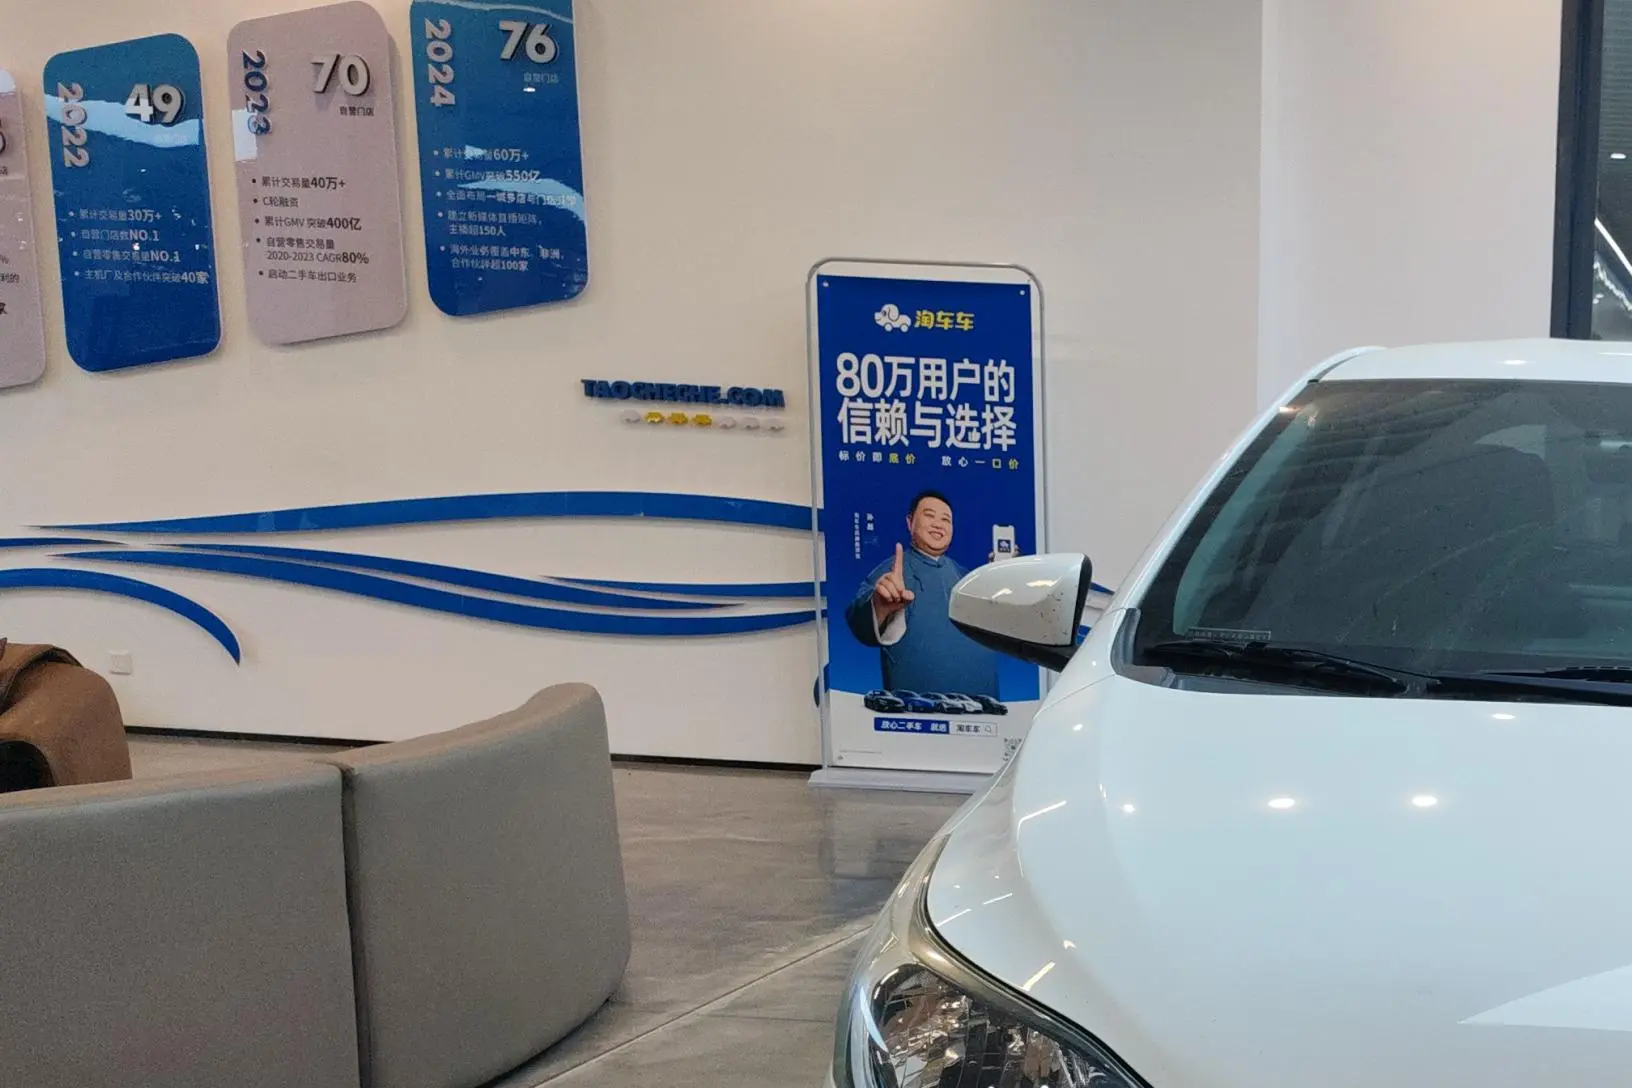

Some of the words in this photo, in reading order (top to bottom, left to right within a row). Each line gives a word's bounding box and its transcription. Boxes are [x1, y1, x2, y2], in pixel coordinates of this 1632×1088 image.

[499, 20, 559, 64] 76
[310, 53, 371, 97] 70
[424, 18, 456, 107] 2024
[125, 83, 185, 126] 49
[242, 49, 272, 136] 2023
[57, 82, 90, 168] 2022
[262, 176, 346, 190] 累计交易量40万+
[262, 196, 299, 208] C轮融资
[266, 236, 335, 250] 自营零售交易量
[267, 251, 315, 261] 2020-2023
[268, 269, 357, 283] 启动二手车出口业务
[914, 310, 975, 331] 淘车车
[581, 379, 786, 407] TAOCHECHE.COM
[836, 352, 1016, 403] 80万用户的
[837, 397, 1017, 451] 信赖与选择
[941, 455, 1020, 470] 放心一口价
